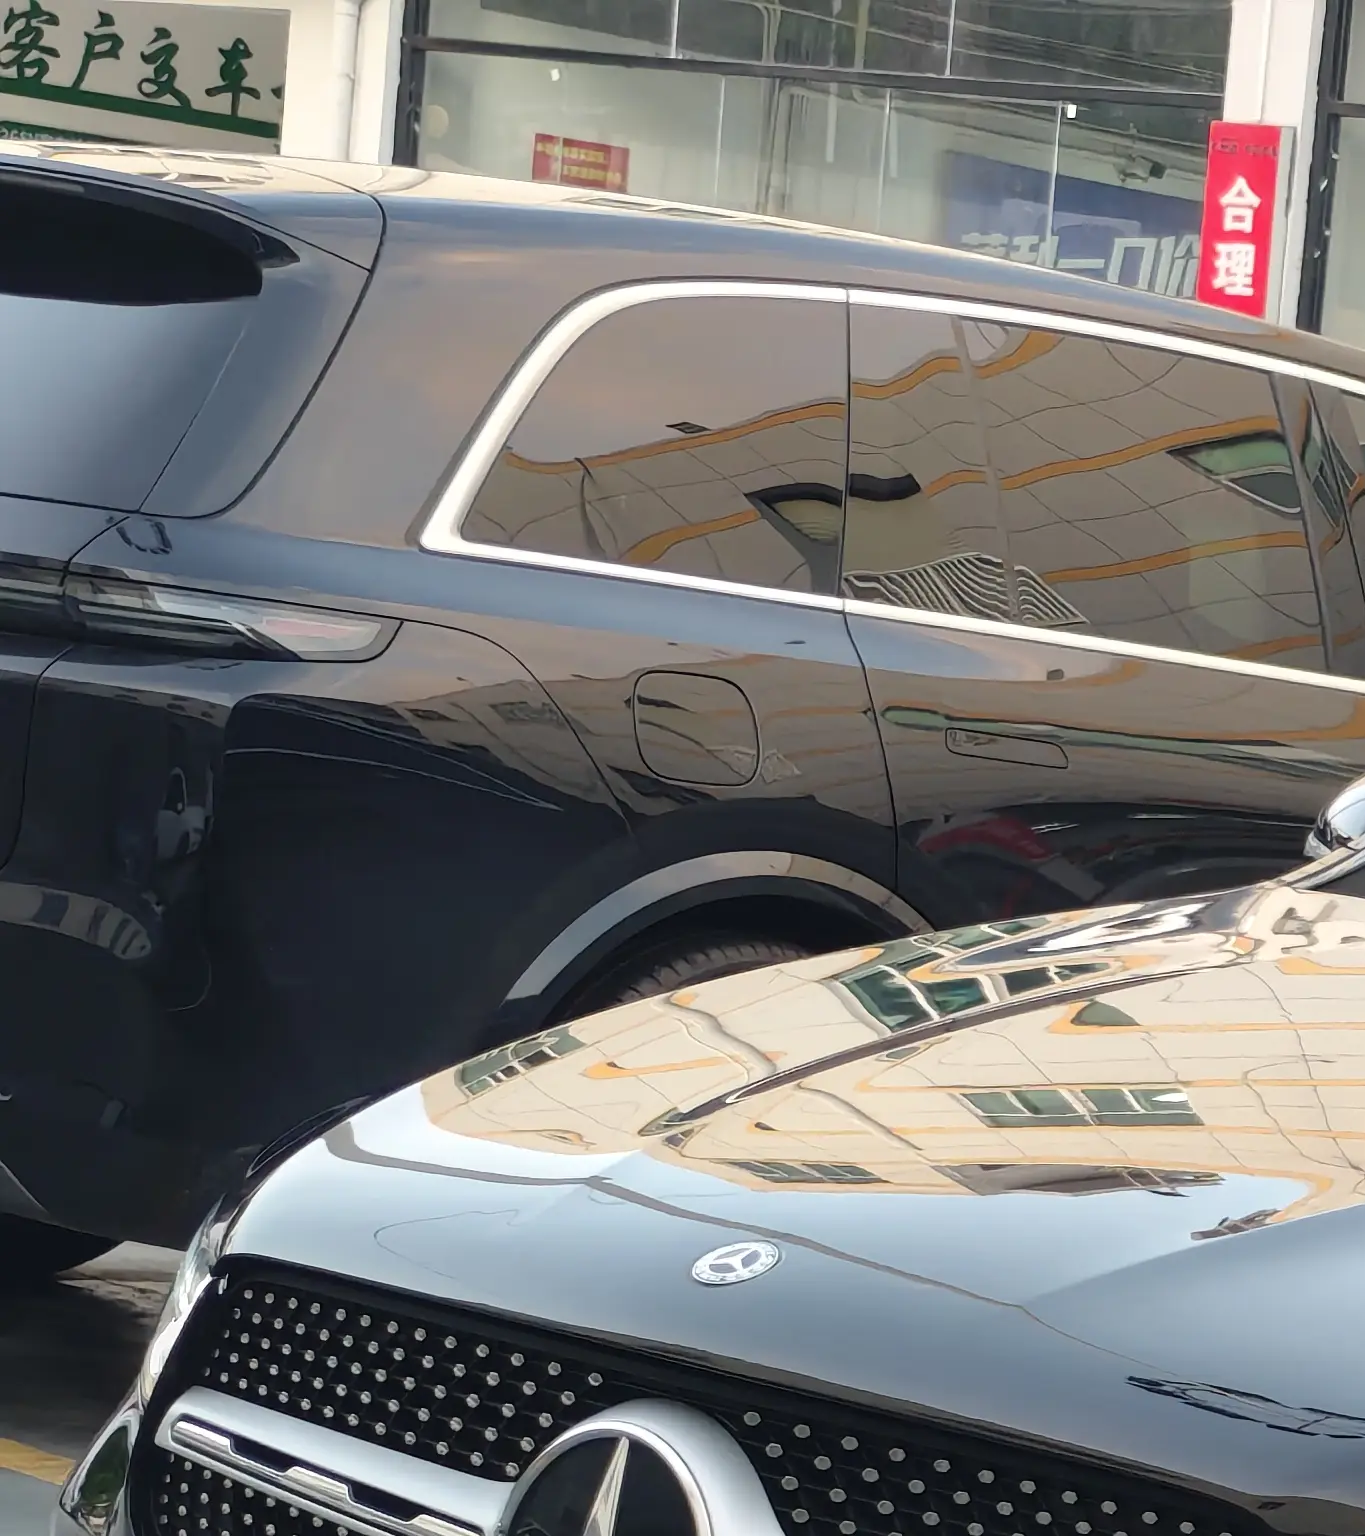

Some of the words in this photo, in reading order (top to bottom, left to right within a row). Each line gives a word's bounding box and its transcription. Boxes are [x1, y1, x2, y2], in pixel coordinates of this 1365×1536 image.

[0, 0, 282, 119] 客户交车
[1210, 174, 1262, 298] 合理
